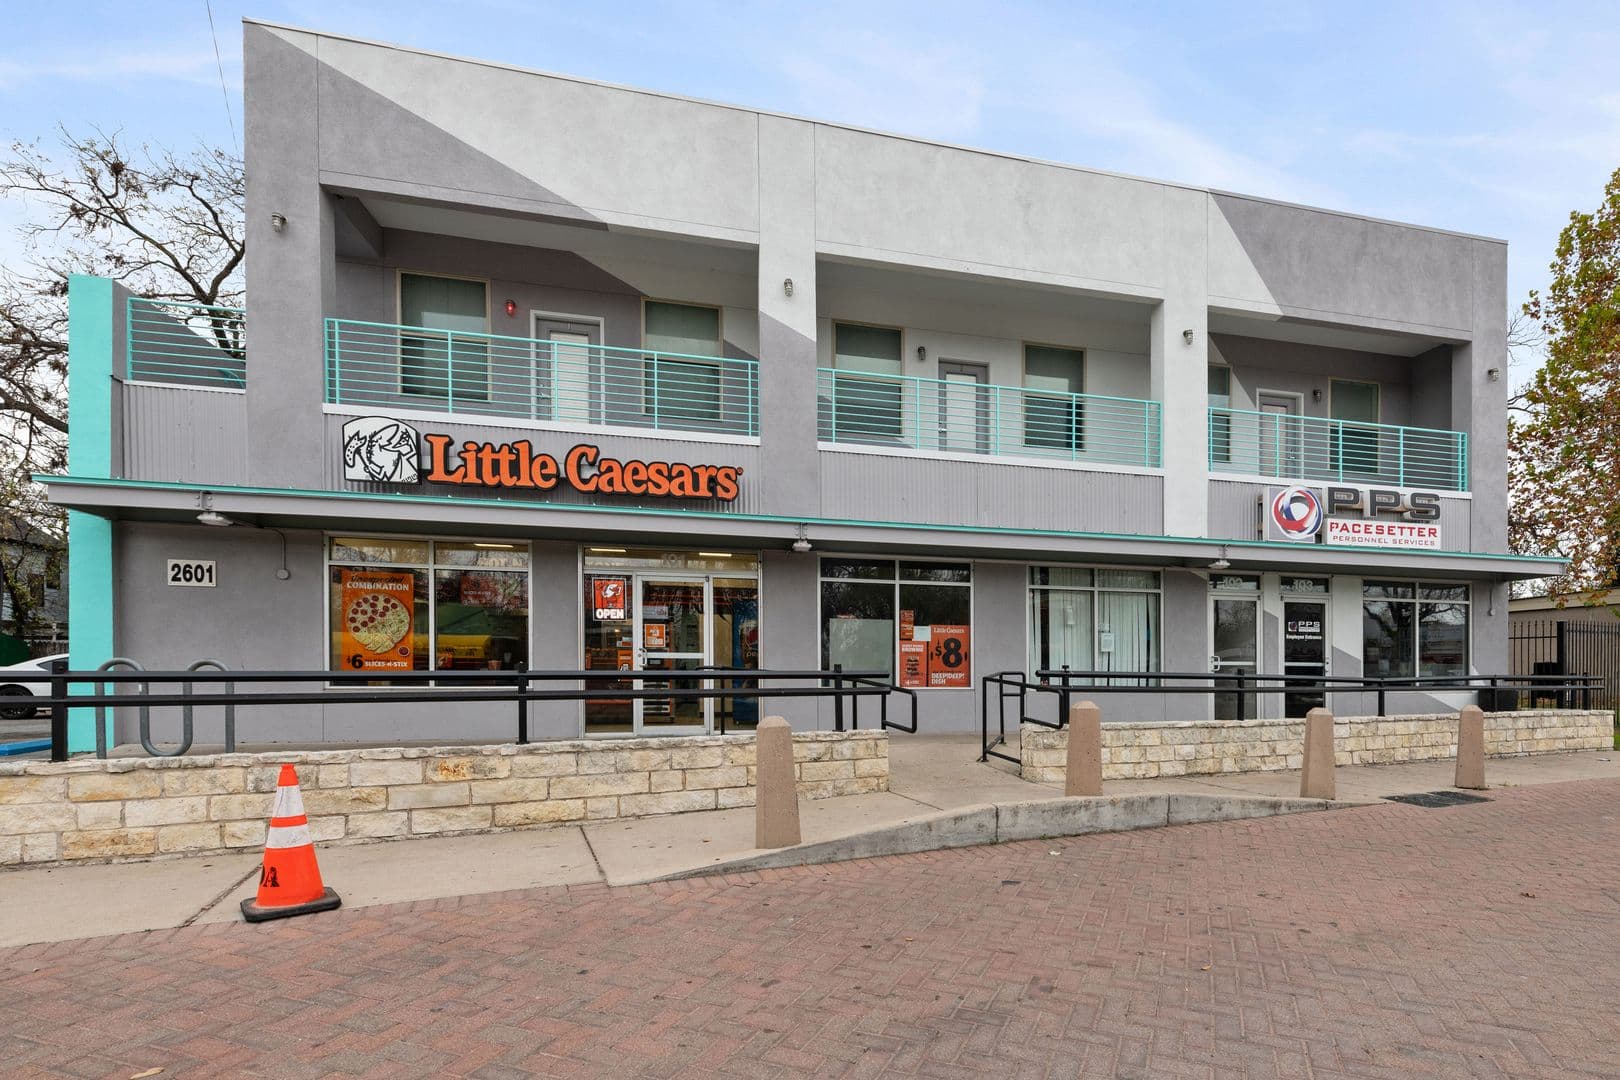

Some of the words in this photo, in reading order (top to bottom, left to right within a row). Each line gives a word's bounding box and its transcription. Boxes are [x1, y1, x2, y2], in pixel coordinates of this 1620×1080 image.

[425, 434, 560, 489] Little
[565, 444, 740, 501] Caesars
[1328, 487, 1440, 519] PPS
[1330, 522, 1438, 538] PACESETTER
[1333, 535, 1388, 544] PERSONNEL
[1392, 538, 1435, 546] SERVICES
[170, 563, 213, 583] 2601
[346, 581, 409, 591] COMBINATION
[595, 608, 625, 619] OPEN
